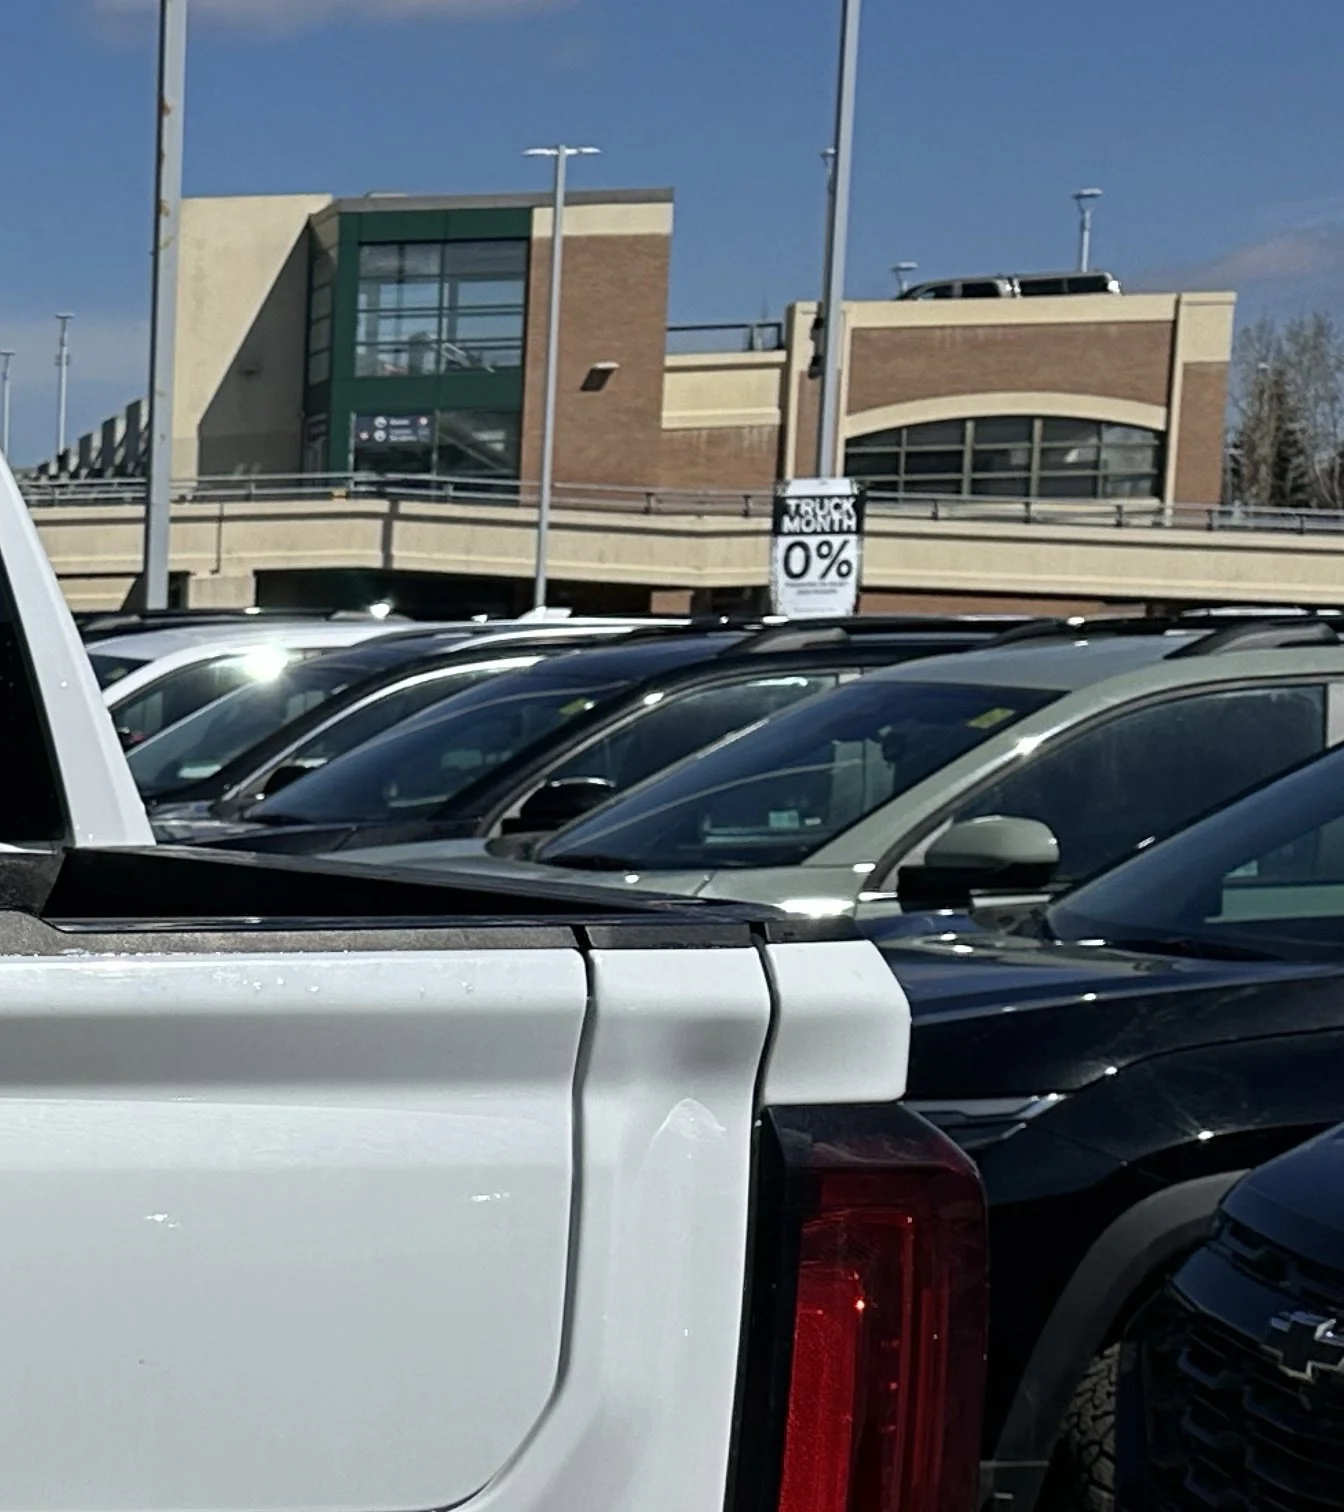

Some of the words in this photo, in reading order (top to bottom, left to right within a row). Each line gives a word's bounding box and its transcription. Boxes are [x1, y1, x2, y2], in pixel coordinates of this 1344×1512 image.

[786, 497, 856, 515] TRUCK
[783, 514, 857, 533] MONTH
[784, 539, 853, 580] 0%
